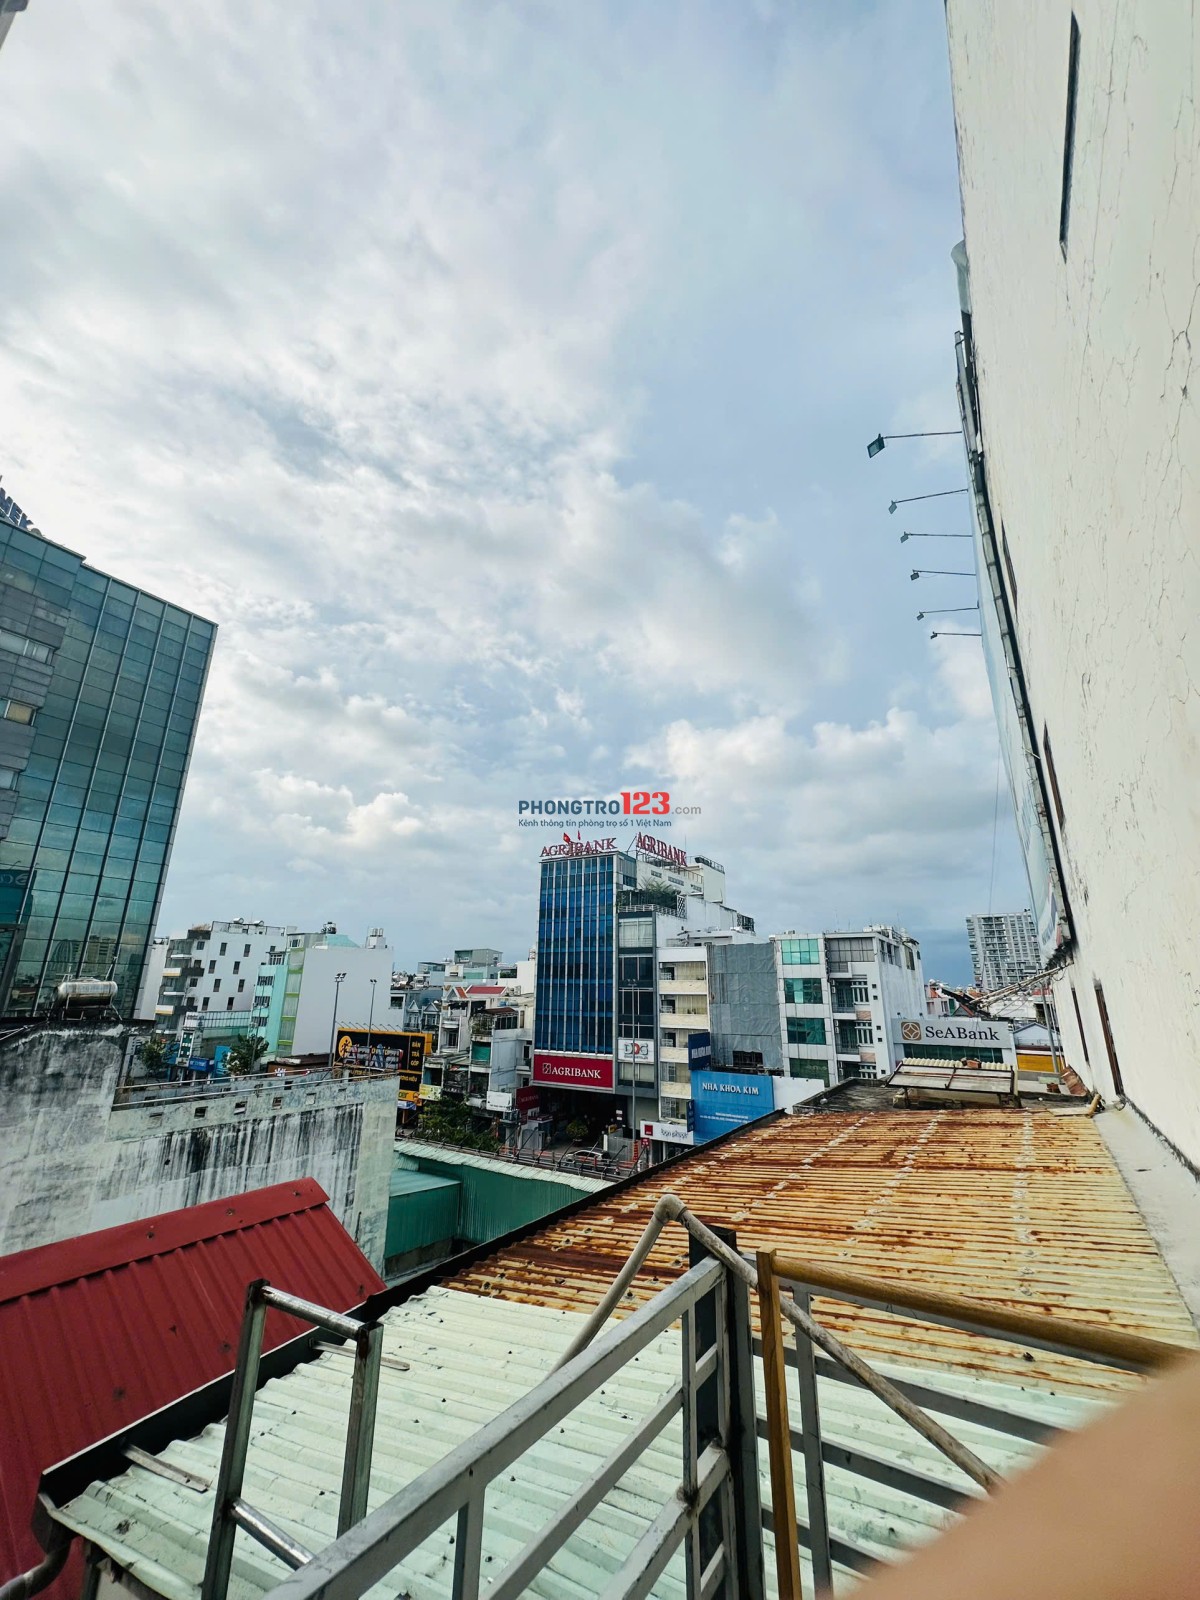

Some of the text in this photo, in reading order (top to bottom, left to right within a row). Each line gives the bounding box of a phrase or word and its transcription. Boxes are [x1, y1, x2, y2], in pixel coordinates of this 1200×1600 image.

[539, 837, 618, 857] AGRIBANK
[635, 832, 688, 867] AGRIBANK
[925, 1026, 1001, 1041] SeABank
[552, 1067, 602, 1079] AGRIBANK
[702, 1082, 759, 1095] NHA KHOA KIM
